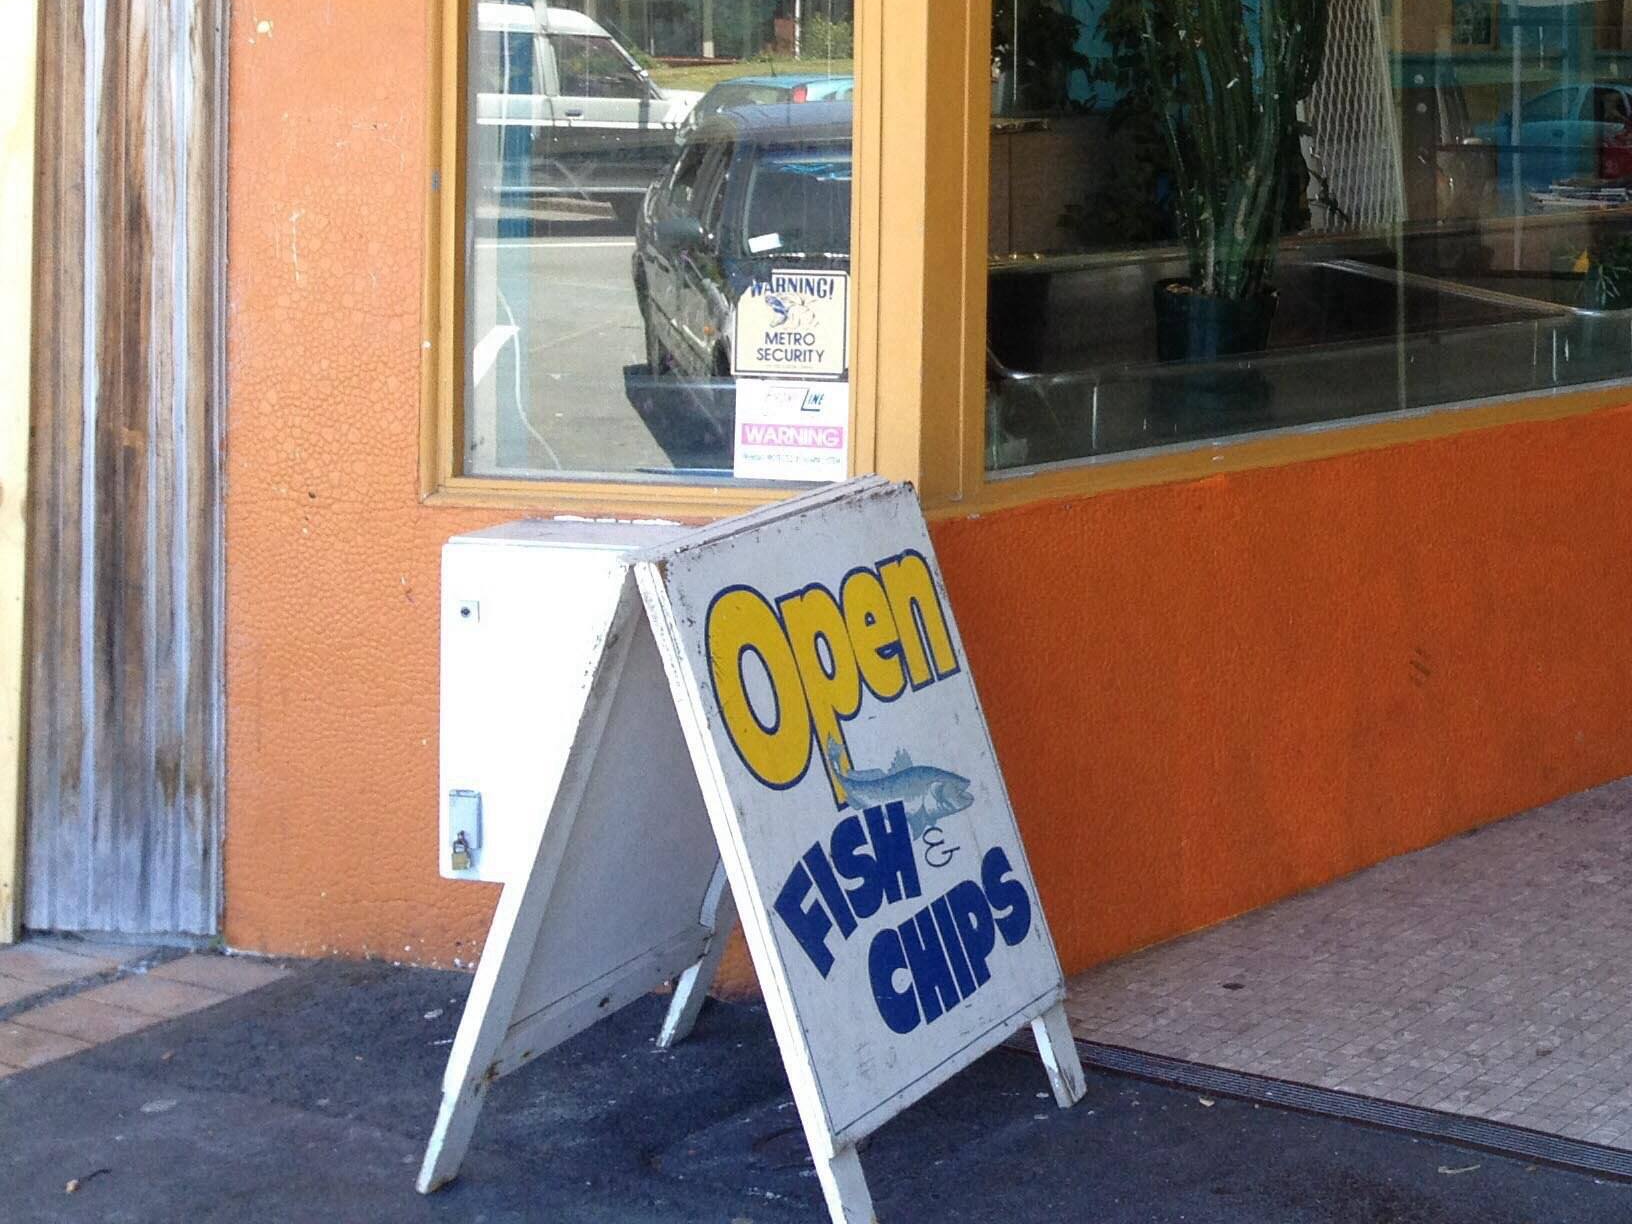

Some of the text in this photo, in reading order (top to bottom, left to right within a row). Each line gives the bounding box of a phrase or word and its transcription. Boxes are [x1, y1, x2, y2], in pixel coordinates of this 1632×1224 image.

[750, 276, 835, 300] WARNING!
[764, 331, 816, 347] METRO
[756, 347, 825, 364] SECURITY
[744, 425, 840, 448] WARNING
[704, 548, 962, 811] Open
[773, 800, 960, 980] FISH &
[867, 845, 1032, 1035] CHIPS
